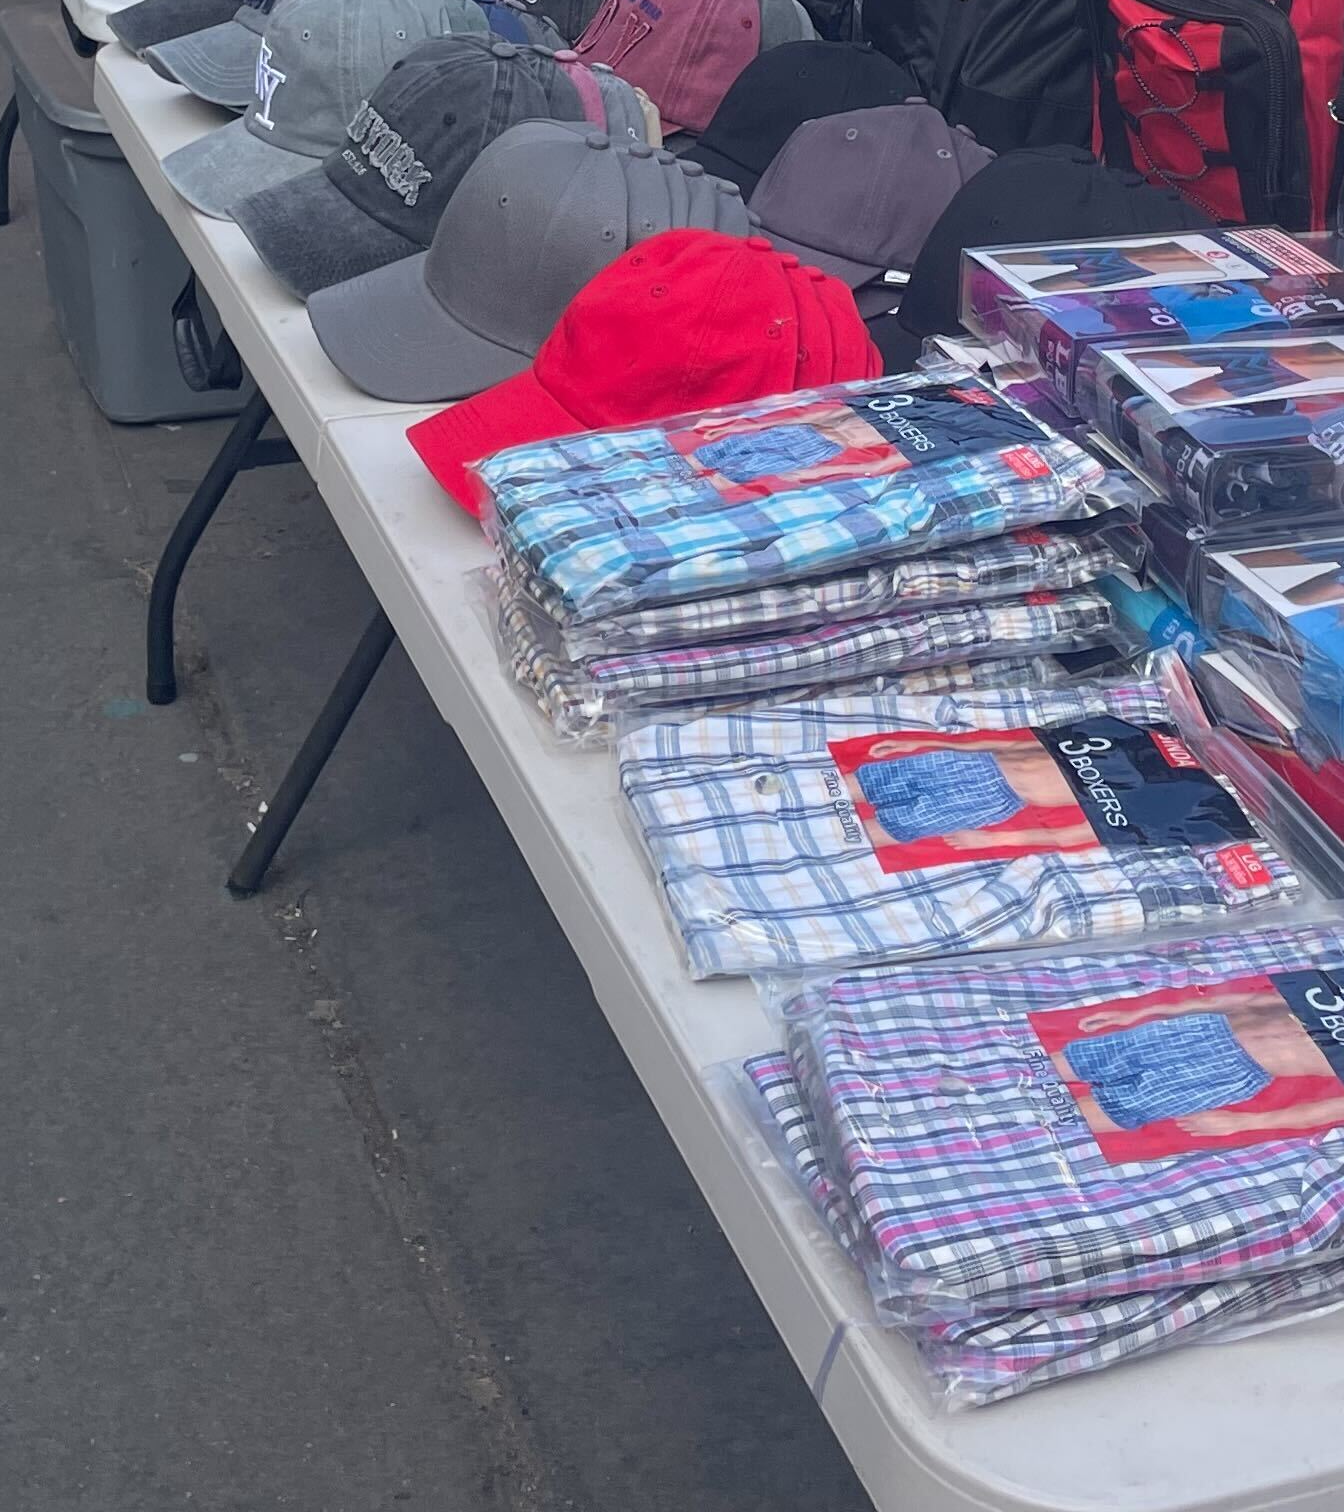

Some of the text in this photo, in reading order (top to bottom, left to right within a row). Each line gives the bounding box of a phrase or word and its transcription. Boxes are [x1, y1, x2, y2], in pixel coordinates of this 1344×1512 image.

[867, 394, 936, 452] 3 BOXERS
[820, 769, 863, 845] Fine Quality
[1058, 736, 1129, 829] 3 BOXERS
[1022, 1047, 1049, 1080] Fine
